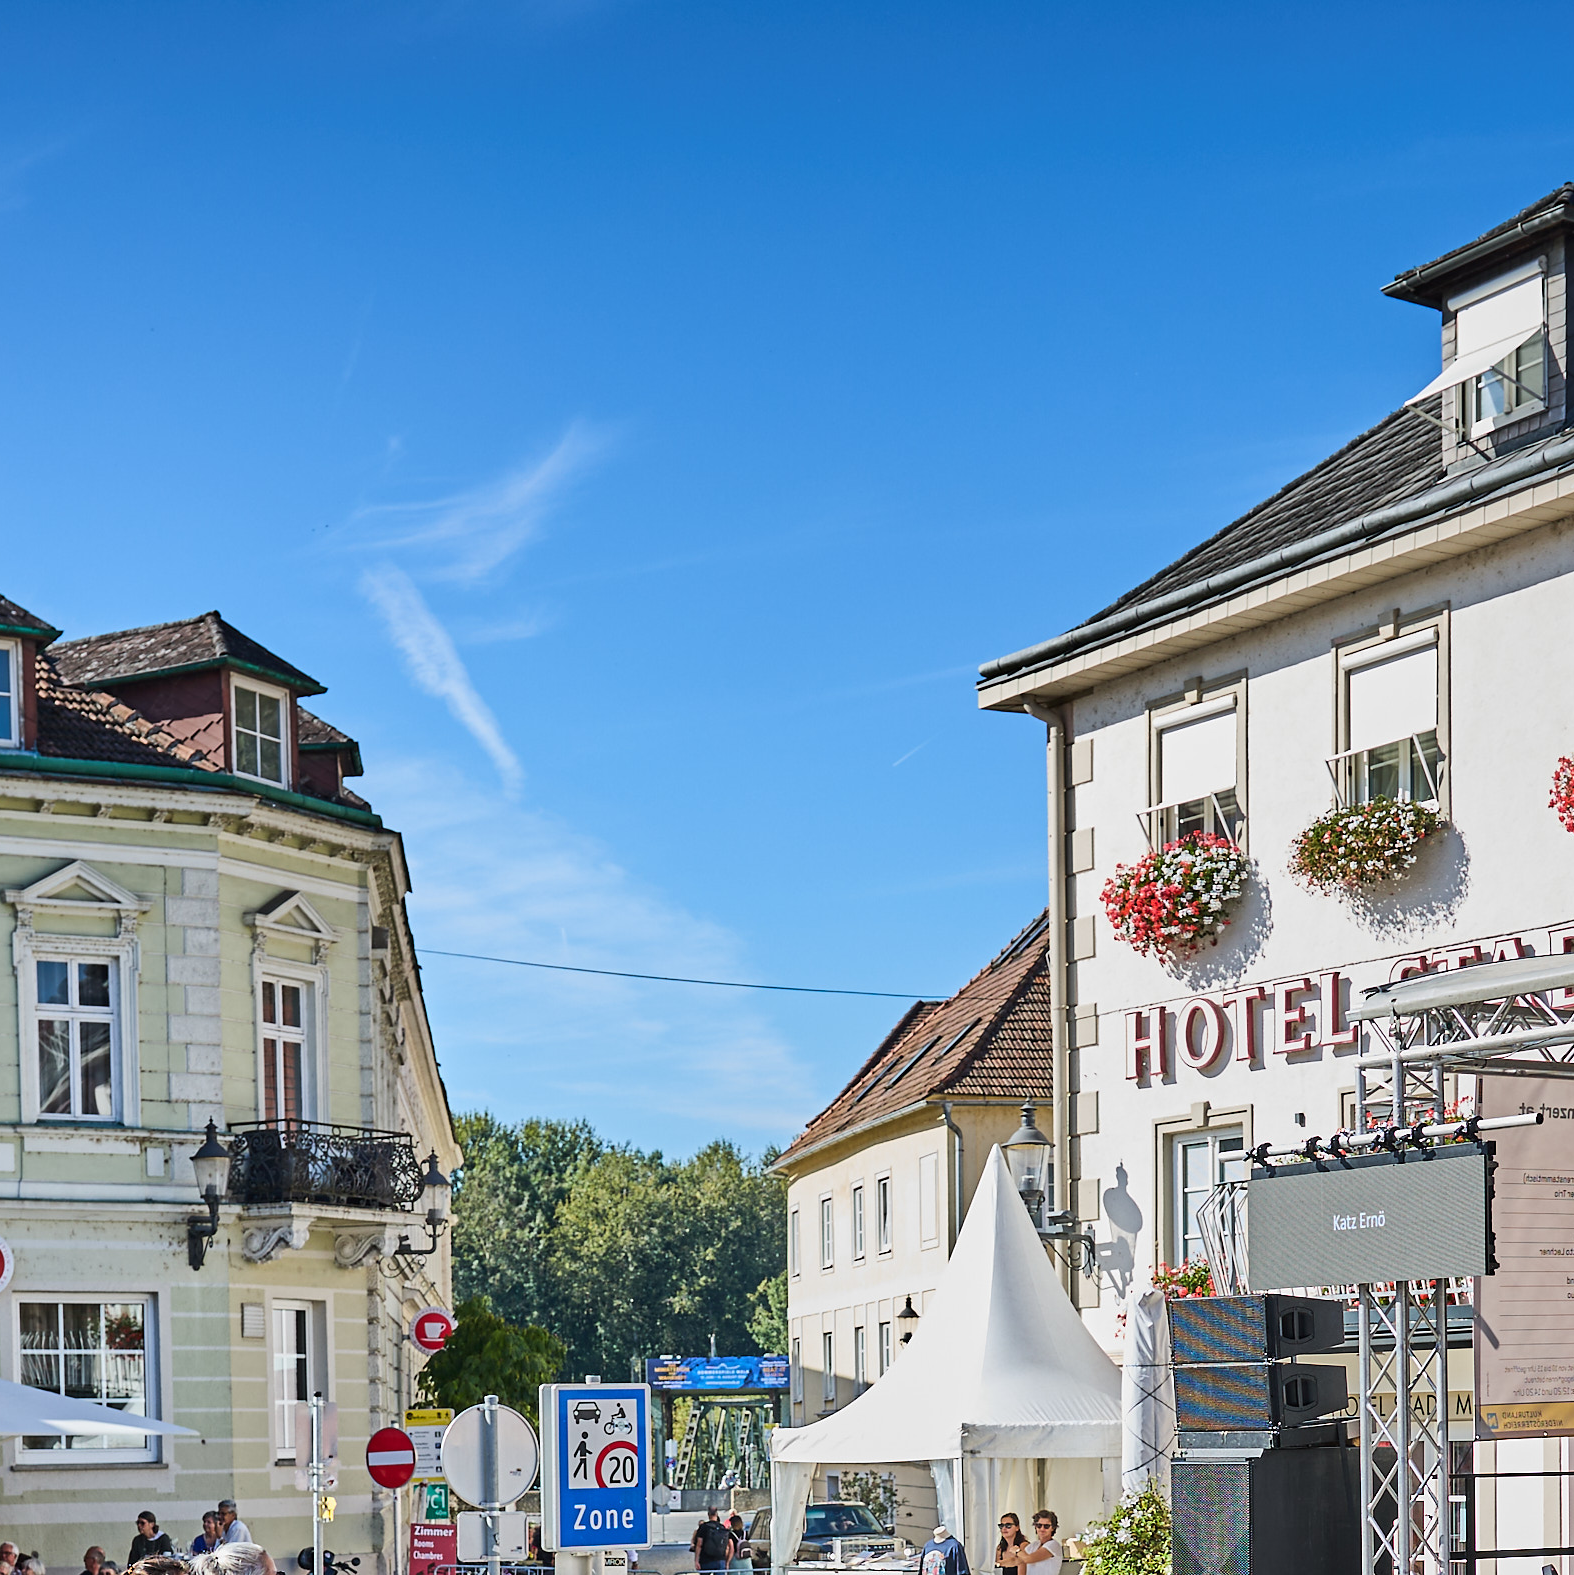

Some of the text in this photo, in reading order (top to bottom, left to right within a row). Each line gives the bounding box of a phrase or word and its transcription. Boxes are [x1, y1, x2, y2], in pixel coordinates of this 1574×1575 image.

[1125, 972, 1359, 1080] HOTEL
[1333, 1210, 1385, 1231] Katz Ernö
[609, 1455, 635, 1484] 20
[573, 1504, 634, 1531] Zone
[414, 1526, 454, 1537] Zimmer
[413, 1538, 435, 1548] Rooms
[413, 1547, 443, 1560] Chambres
